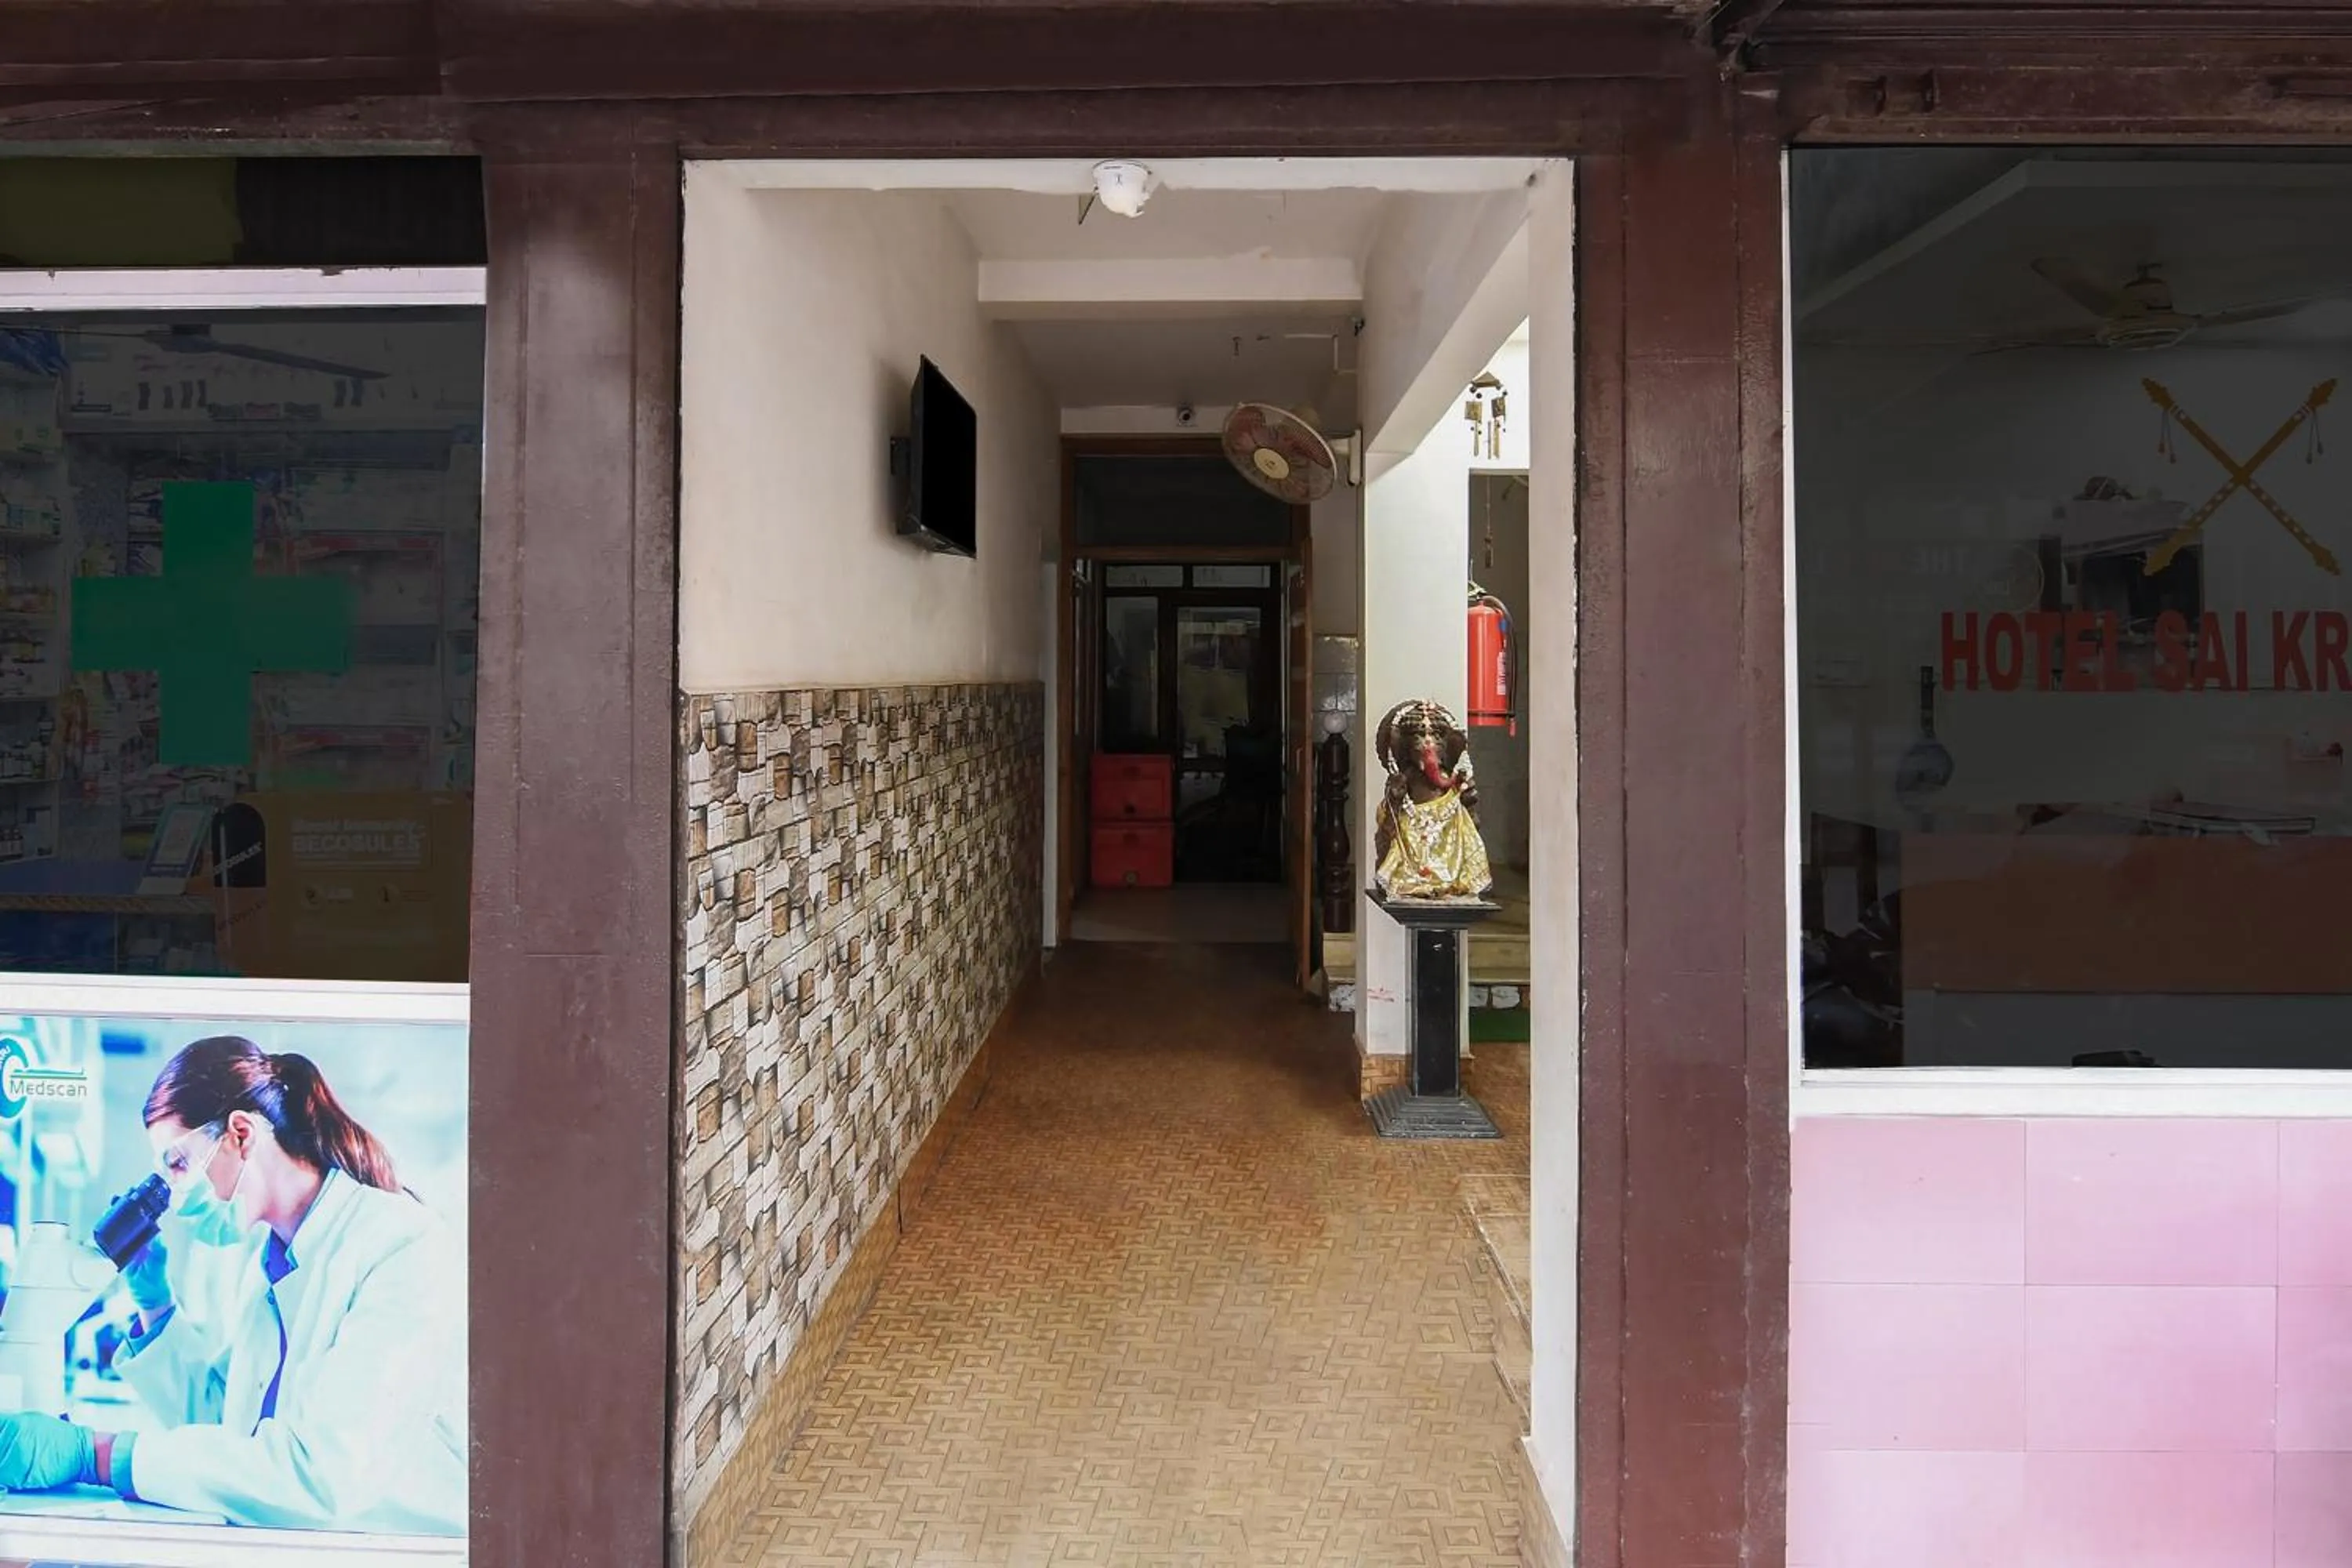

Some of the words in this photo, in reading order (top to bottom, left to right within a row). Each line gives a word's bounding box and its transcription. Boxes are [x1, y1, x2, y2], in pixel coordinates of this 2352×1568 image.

[1940, 611, 2136, 692] HOTEL
[2154, 609, 2249, 692] SAI
[2273, 610, 2352, 692] KR
[9, 1080, 88, 1097] Medscan
